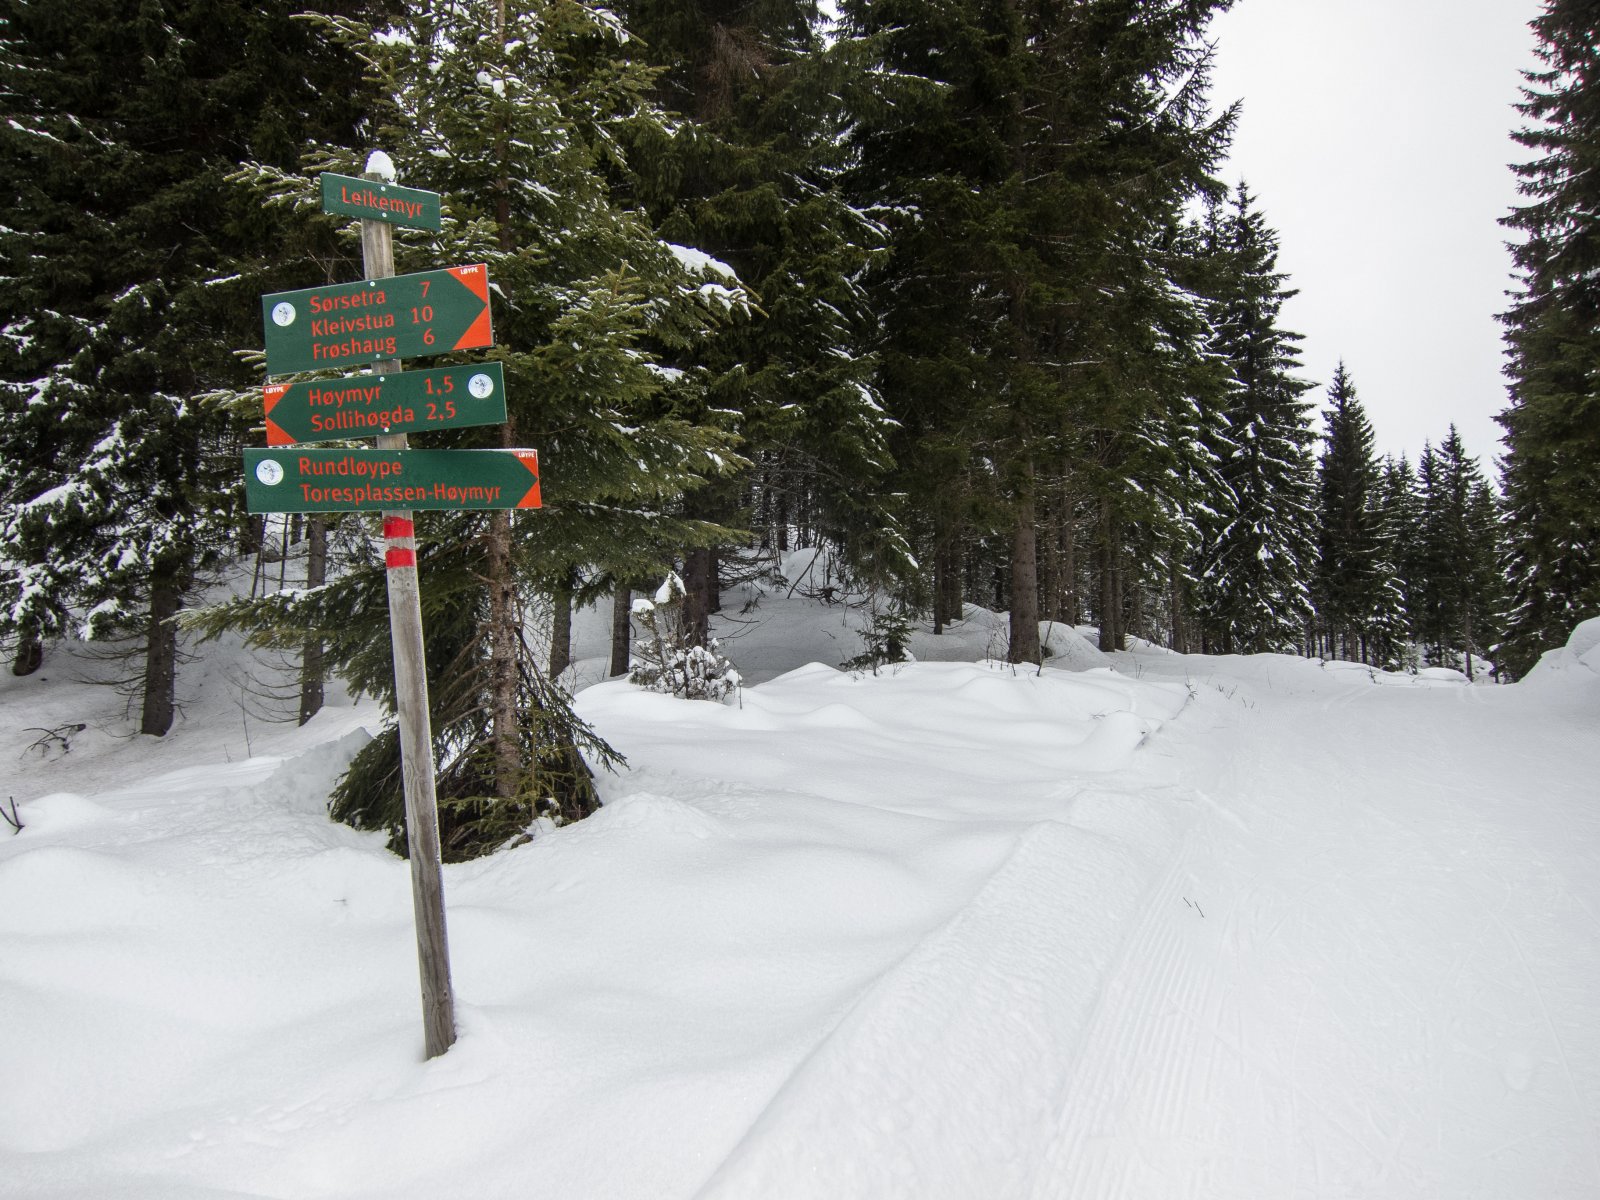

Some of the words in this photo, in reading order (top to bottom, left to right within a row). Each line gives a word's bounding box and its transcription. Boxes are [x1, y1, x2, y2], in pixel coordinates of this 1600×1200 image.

[341, 186, 423, 220] Leikemyr
[460, 267, 479, 275] LØYPE
[310, 290, 386, 314] Sørsetra
[420, 281, 431, 298] 7
[311, 312, 395, 337] Kleivstua
[411, 305, 433, 324] 10
[313, 335, 397, 360] Frøshaug
[423, 328, 435, 345] 6
[265, 386, 284, 394] LØYPE
[309, 386, 382, 408] Høymyr
[424, 376, 454, 396] 1,5
[311, 405, 415, 432] Sollihøgda
[426, 402, 457, 422] 2,5
[299, 457, 403, 479] Rundløype
[301, 482, 501, 505] Toresplassen-Høymyr
